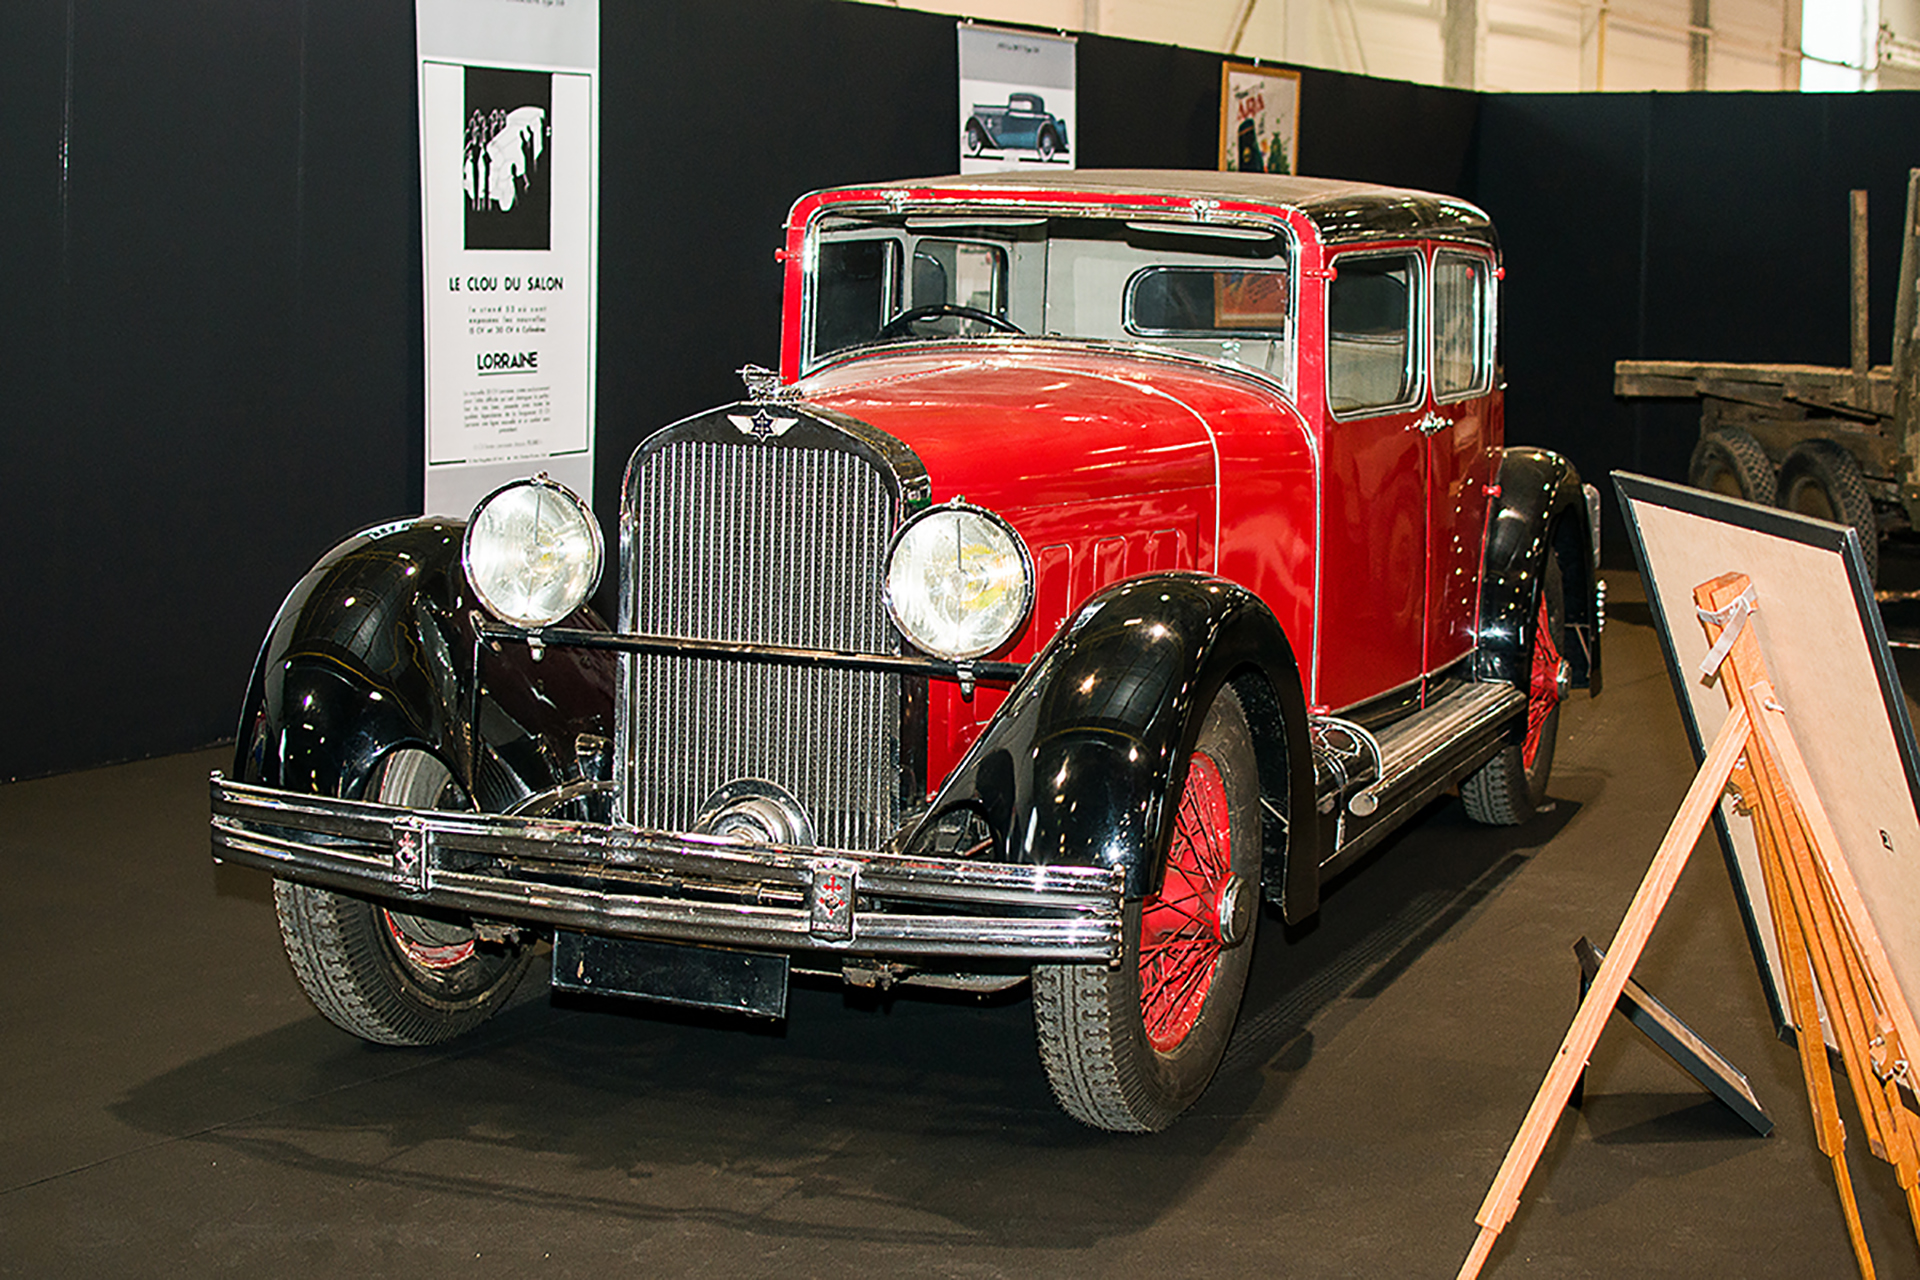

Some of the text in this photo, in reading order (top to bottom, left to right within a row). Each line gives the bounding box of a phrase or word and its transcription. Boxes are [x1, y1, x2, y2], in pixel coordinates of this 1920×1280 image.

[449, 276, 563, 291] LE CLOU DU SALON
[477, 351, 538, 370] LORRAINE
